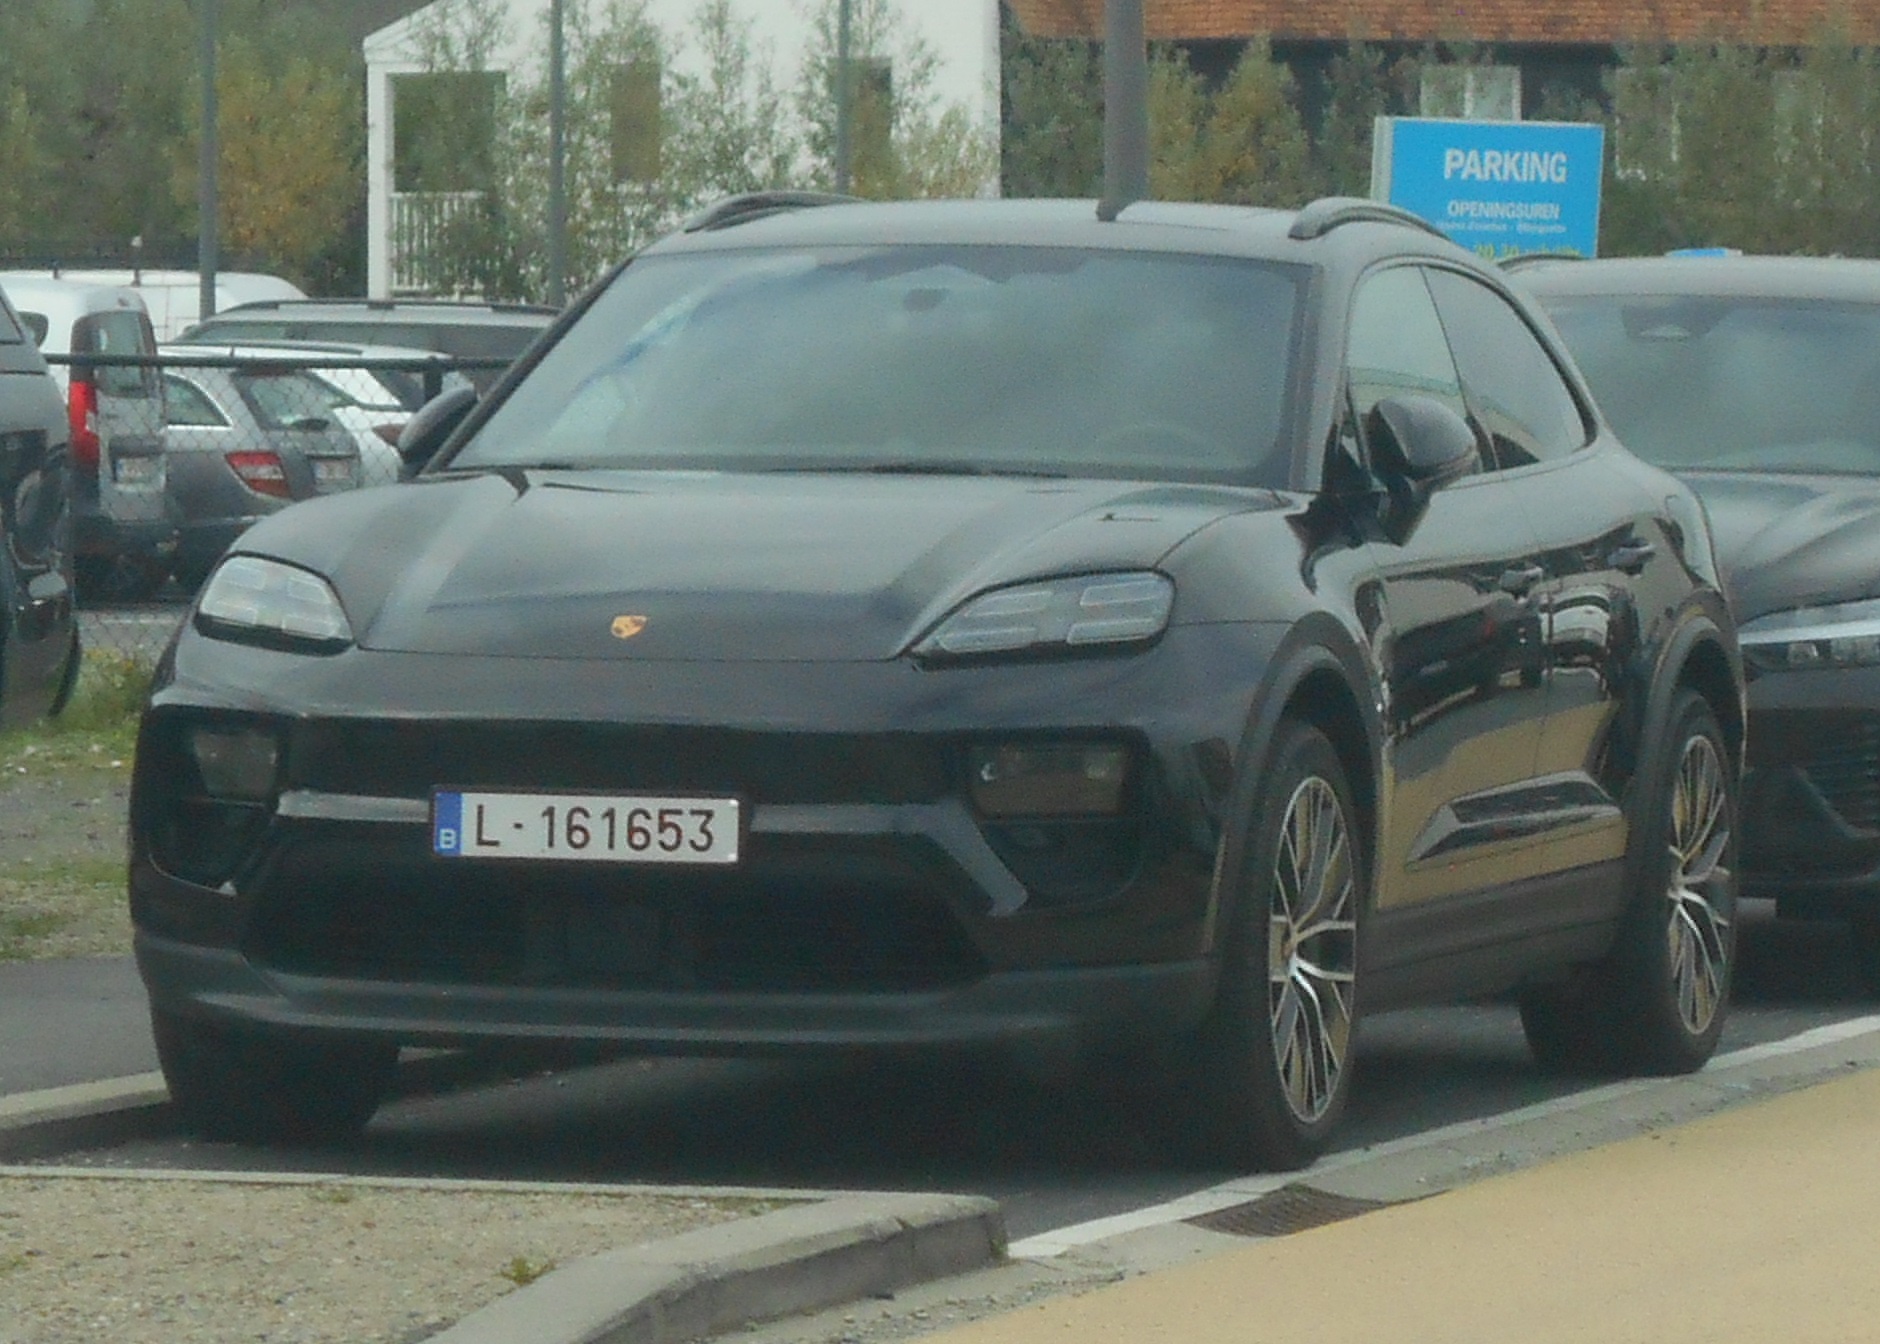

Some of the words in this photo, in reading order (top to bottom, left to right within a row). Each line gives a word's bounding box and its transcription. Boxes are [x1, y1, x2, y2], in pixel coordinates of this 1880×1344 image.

[1444, 148, 1567, 183] PARKING
[1447, 200, 1560, 220] OPENINGSUREN
[439, 828, 456, 849] B
